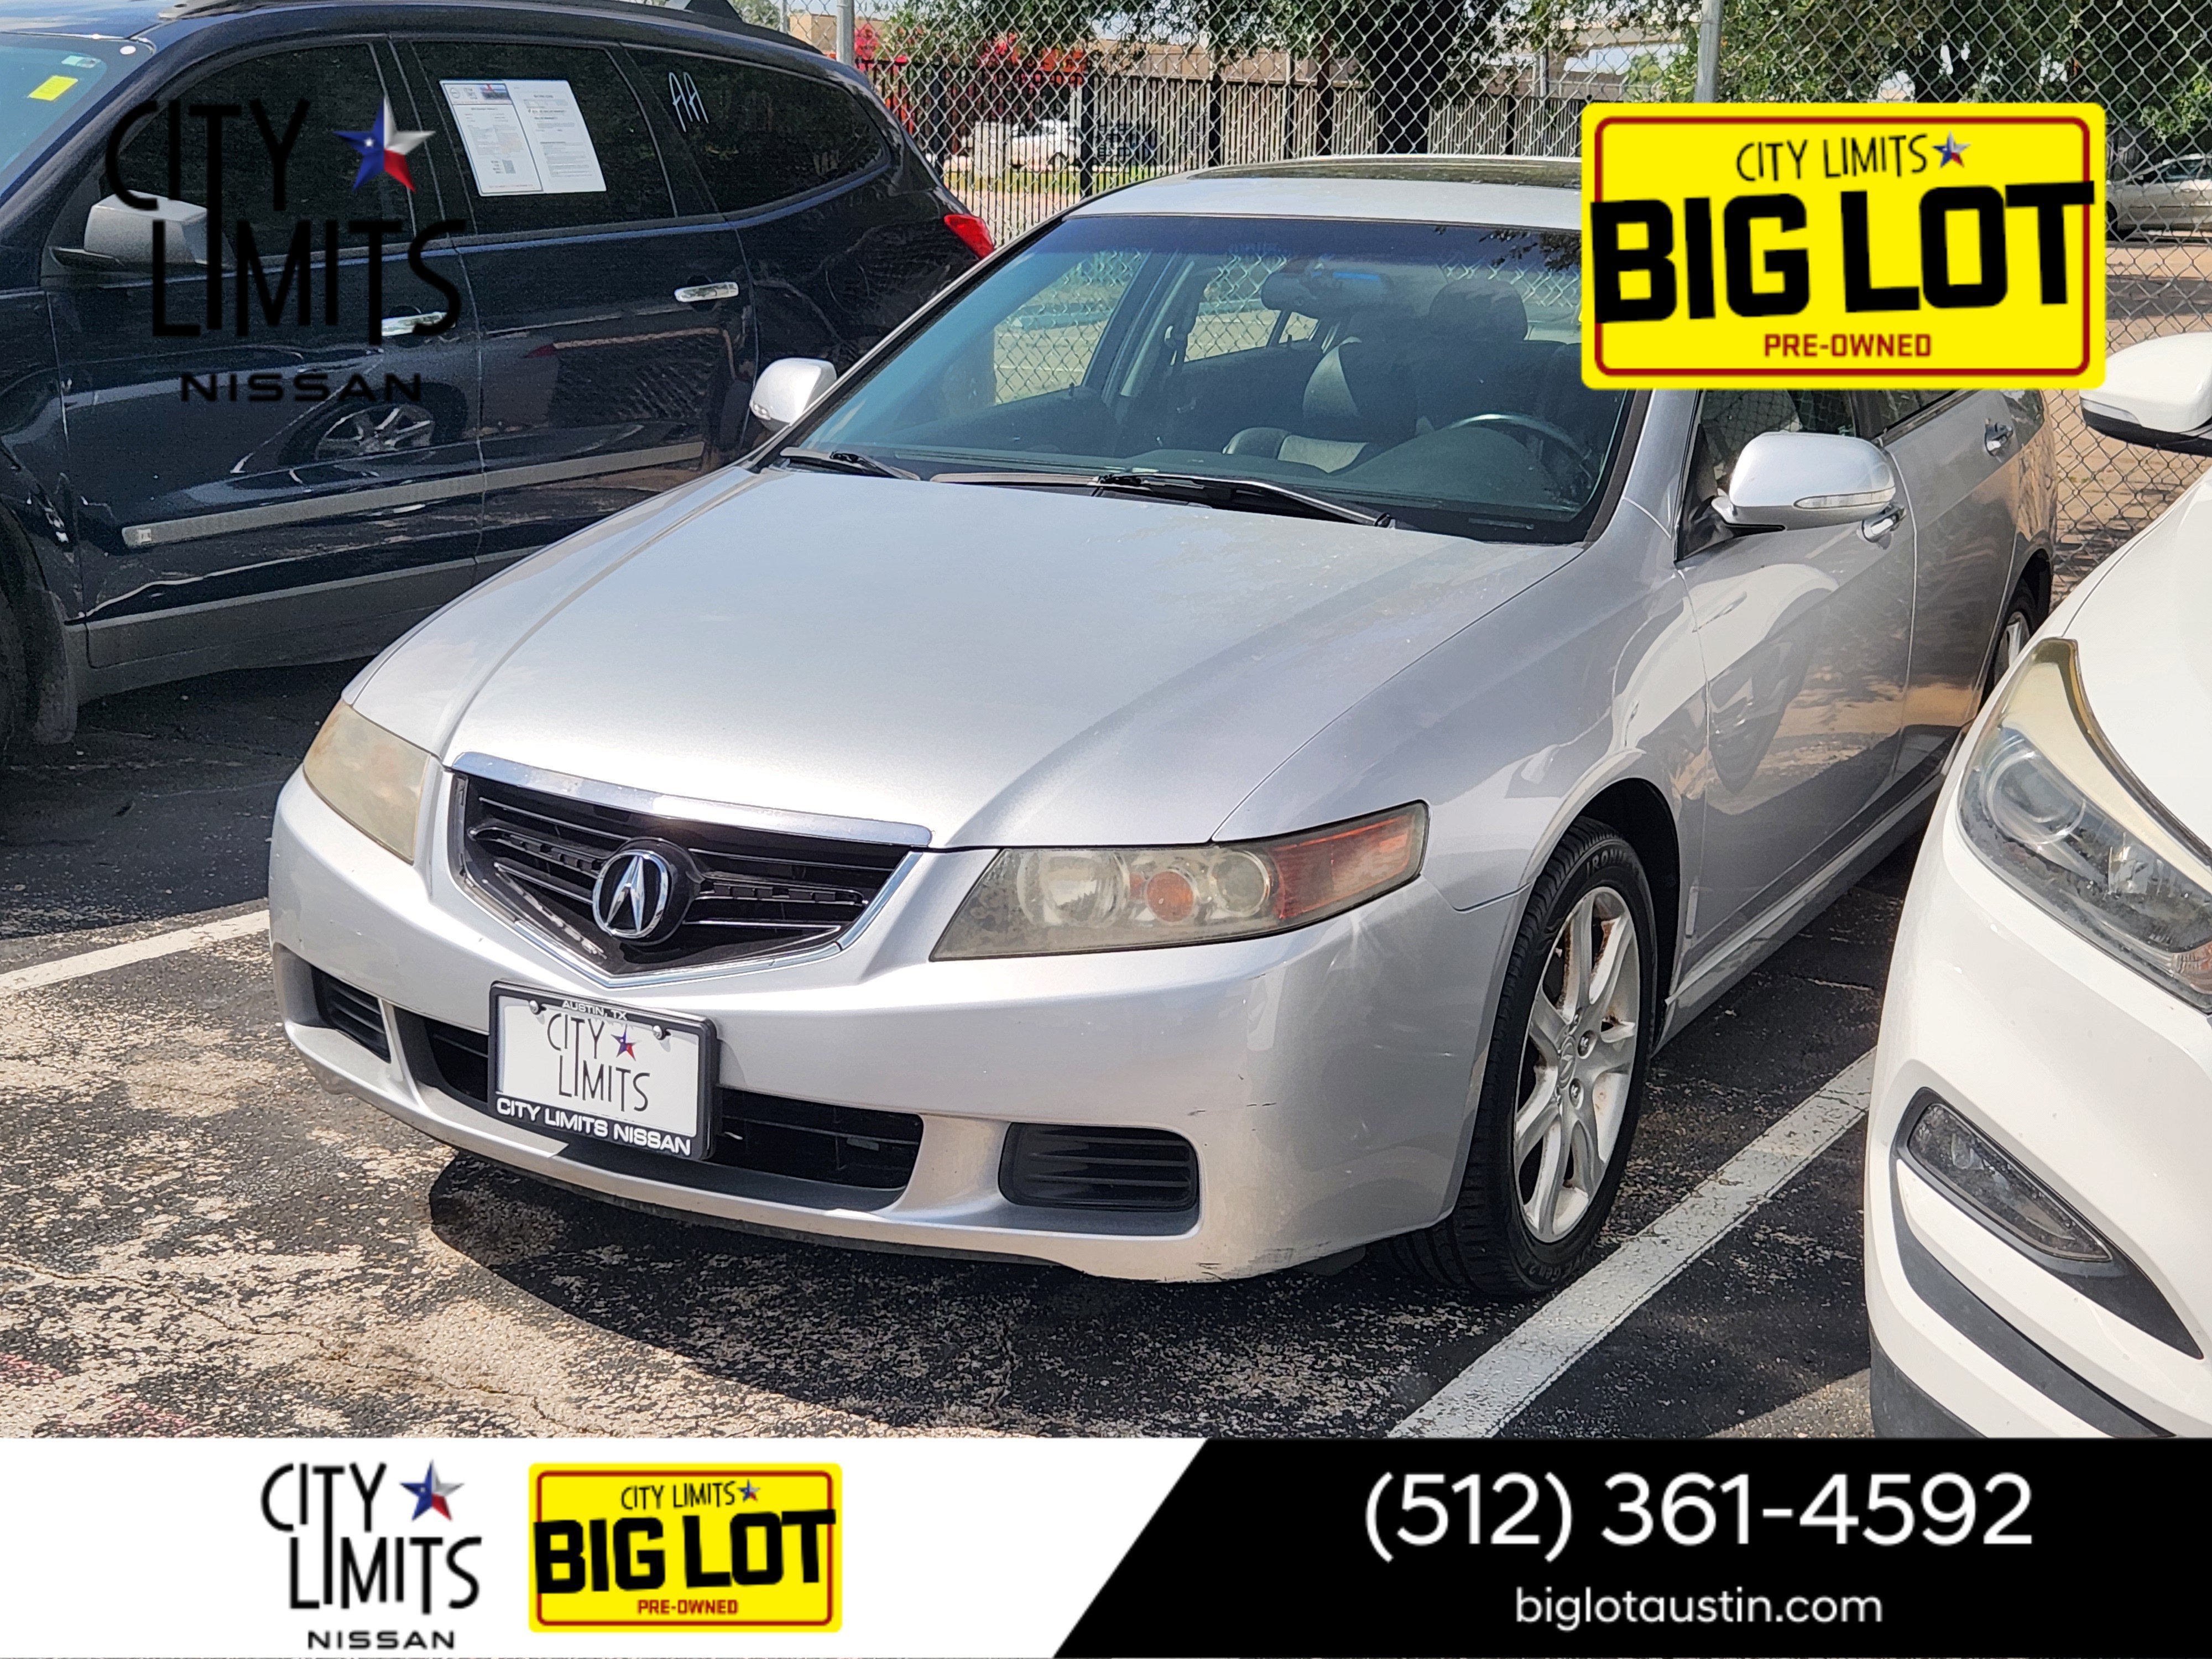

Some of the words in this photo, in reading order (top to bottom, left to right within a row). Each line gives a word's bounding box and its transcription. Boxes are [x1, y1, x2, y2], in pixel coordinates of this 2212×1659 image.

[562, 1000, 608, 1016] AUSTIN,
[611, 1009, 628, 1021] TX
[547, 1013, 604, 1063] CITY
[558, 1055, 650, 1112] LIMITS
[497, 1097, 541, 1121] CITY
[544, 1107, 608, 1138] LIMITS
[613, 1124, 691, 1156] NISSAN
